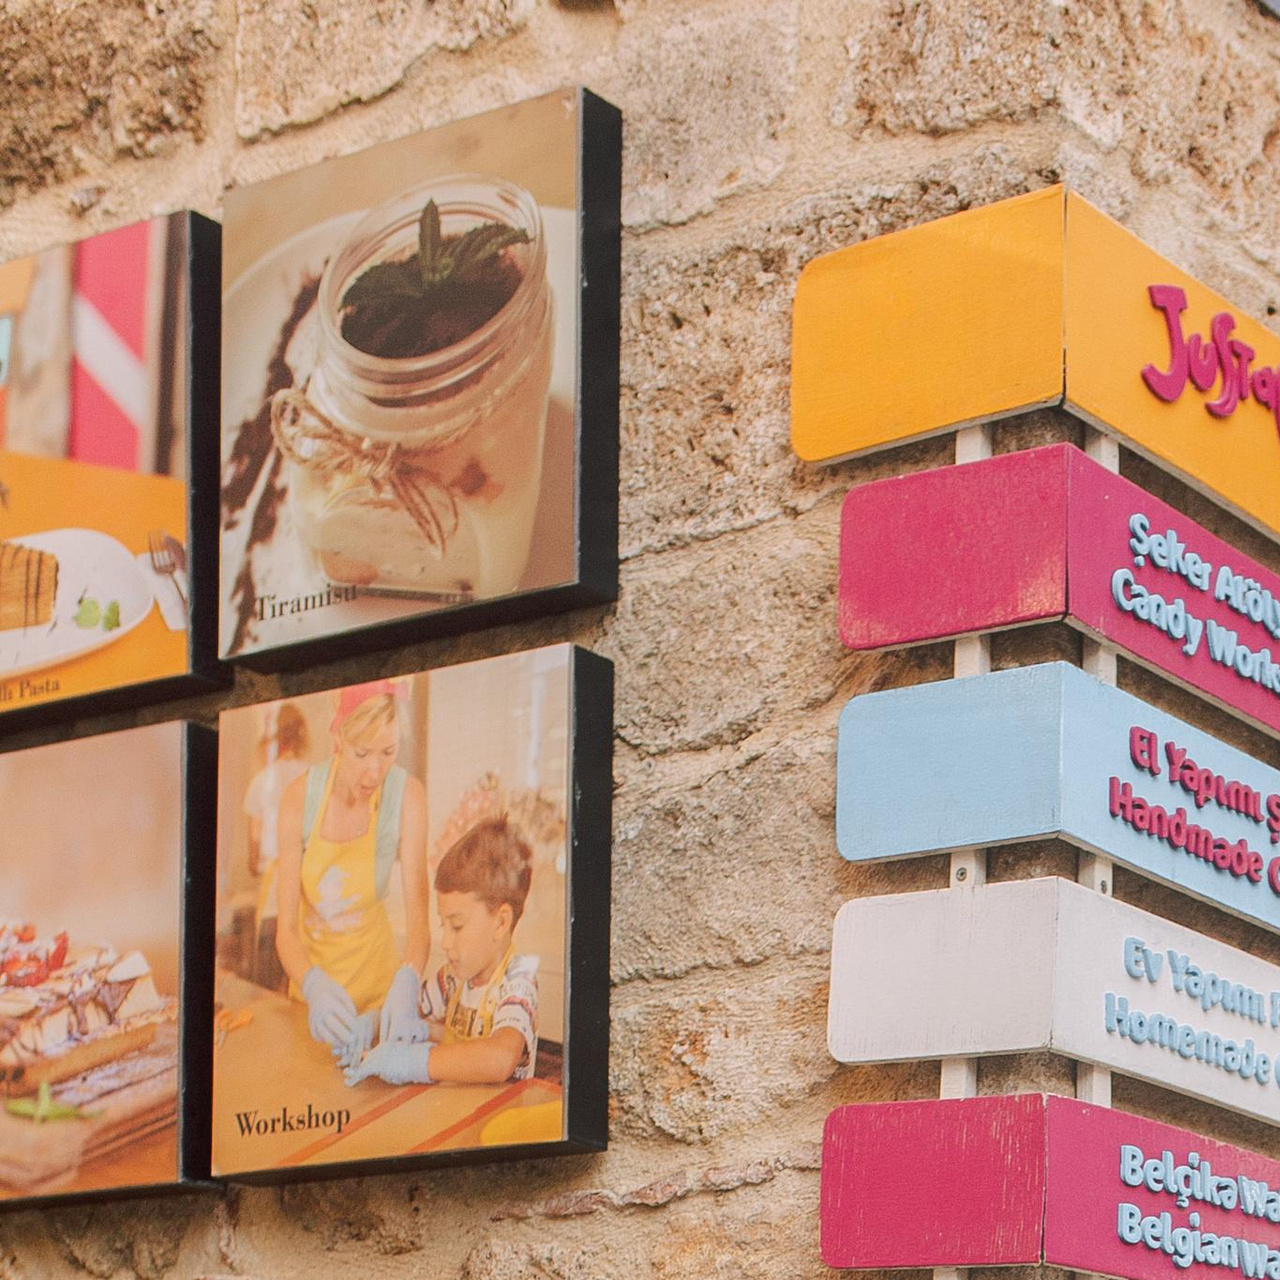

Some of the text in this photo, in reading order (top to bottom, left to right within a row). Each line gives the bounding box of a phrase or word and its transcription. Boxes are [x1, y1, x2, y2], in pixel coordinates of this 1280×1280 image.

[1128, 512, 1212, 591] Şeker
[1111, 568, 1203, 656] Candy
[19, 678, 60, 698] Pasta
[1129, 726, 1161, 776] El
[1165, 741, 1265, 823] Yapımı
[1109, 776, 1264, 883] Handmade
[1124, 936, 1163, 983] Ev
[1166, 949, 1267, 1025] Yapımı
[1104, 991, 1271, 1085] Homemade
[235, 1103, 351, 1138] Workshop
[1120, 1144, 1238, 1209] Belçika
[1117, 1202, 1239, 1268] Belgian
